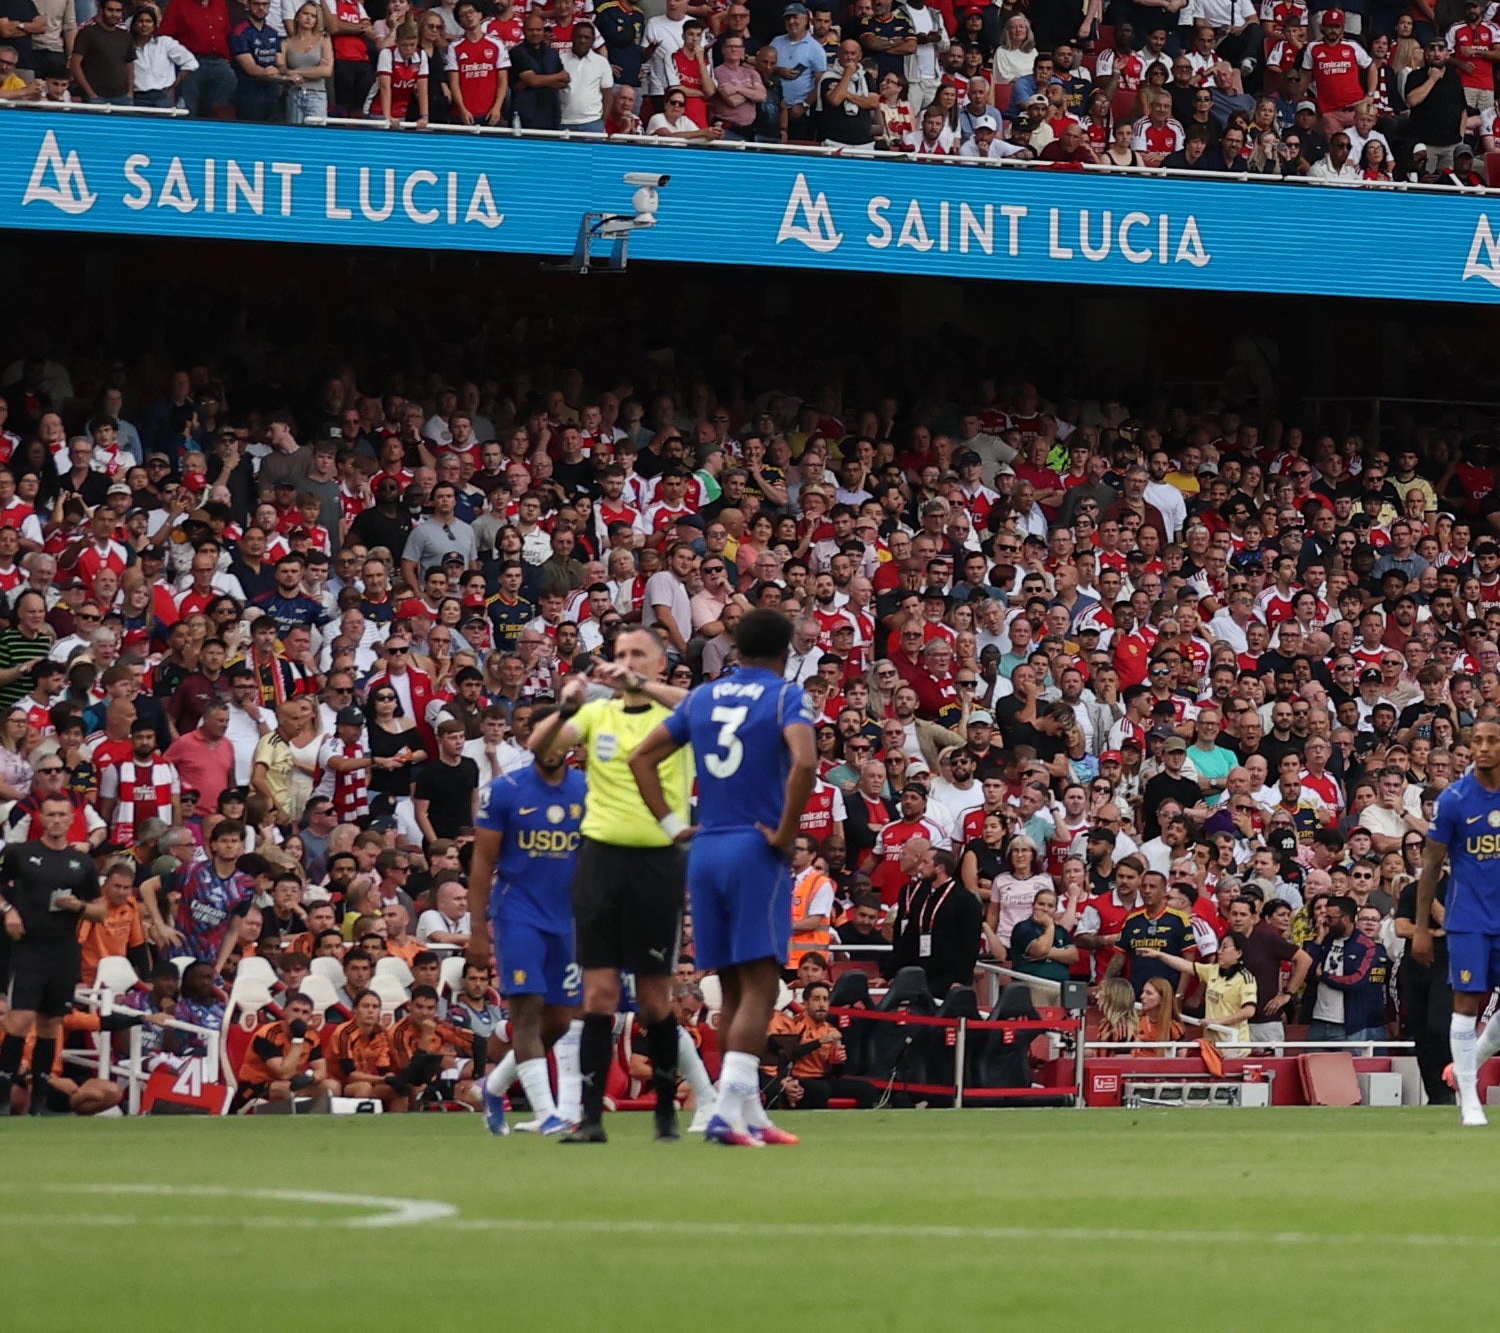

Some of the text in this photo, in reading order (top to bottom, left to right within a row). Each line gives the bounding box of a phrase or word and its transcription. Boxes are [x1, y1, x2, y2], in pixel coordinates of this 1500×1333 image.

[122, 152, 505, 229] SAINT LUCIA
[867, 195, 1212, 268] SAINT LUCIA
[703, 705, 749, 780] 3
[519, 830, 581, 852] USDC
